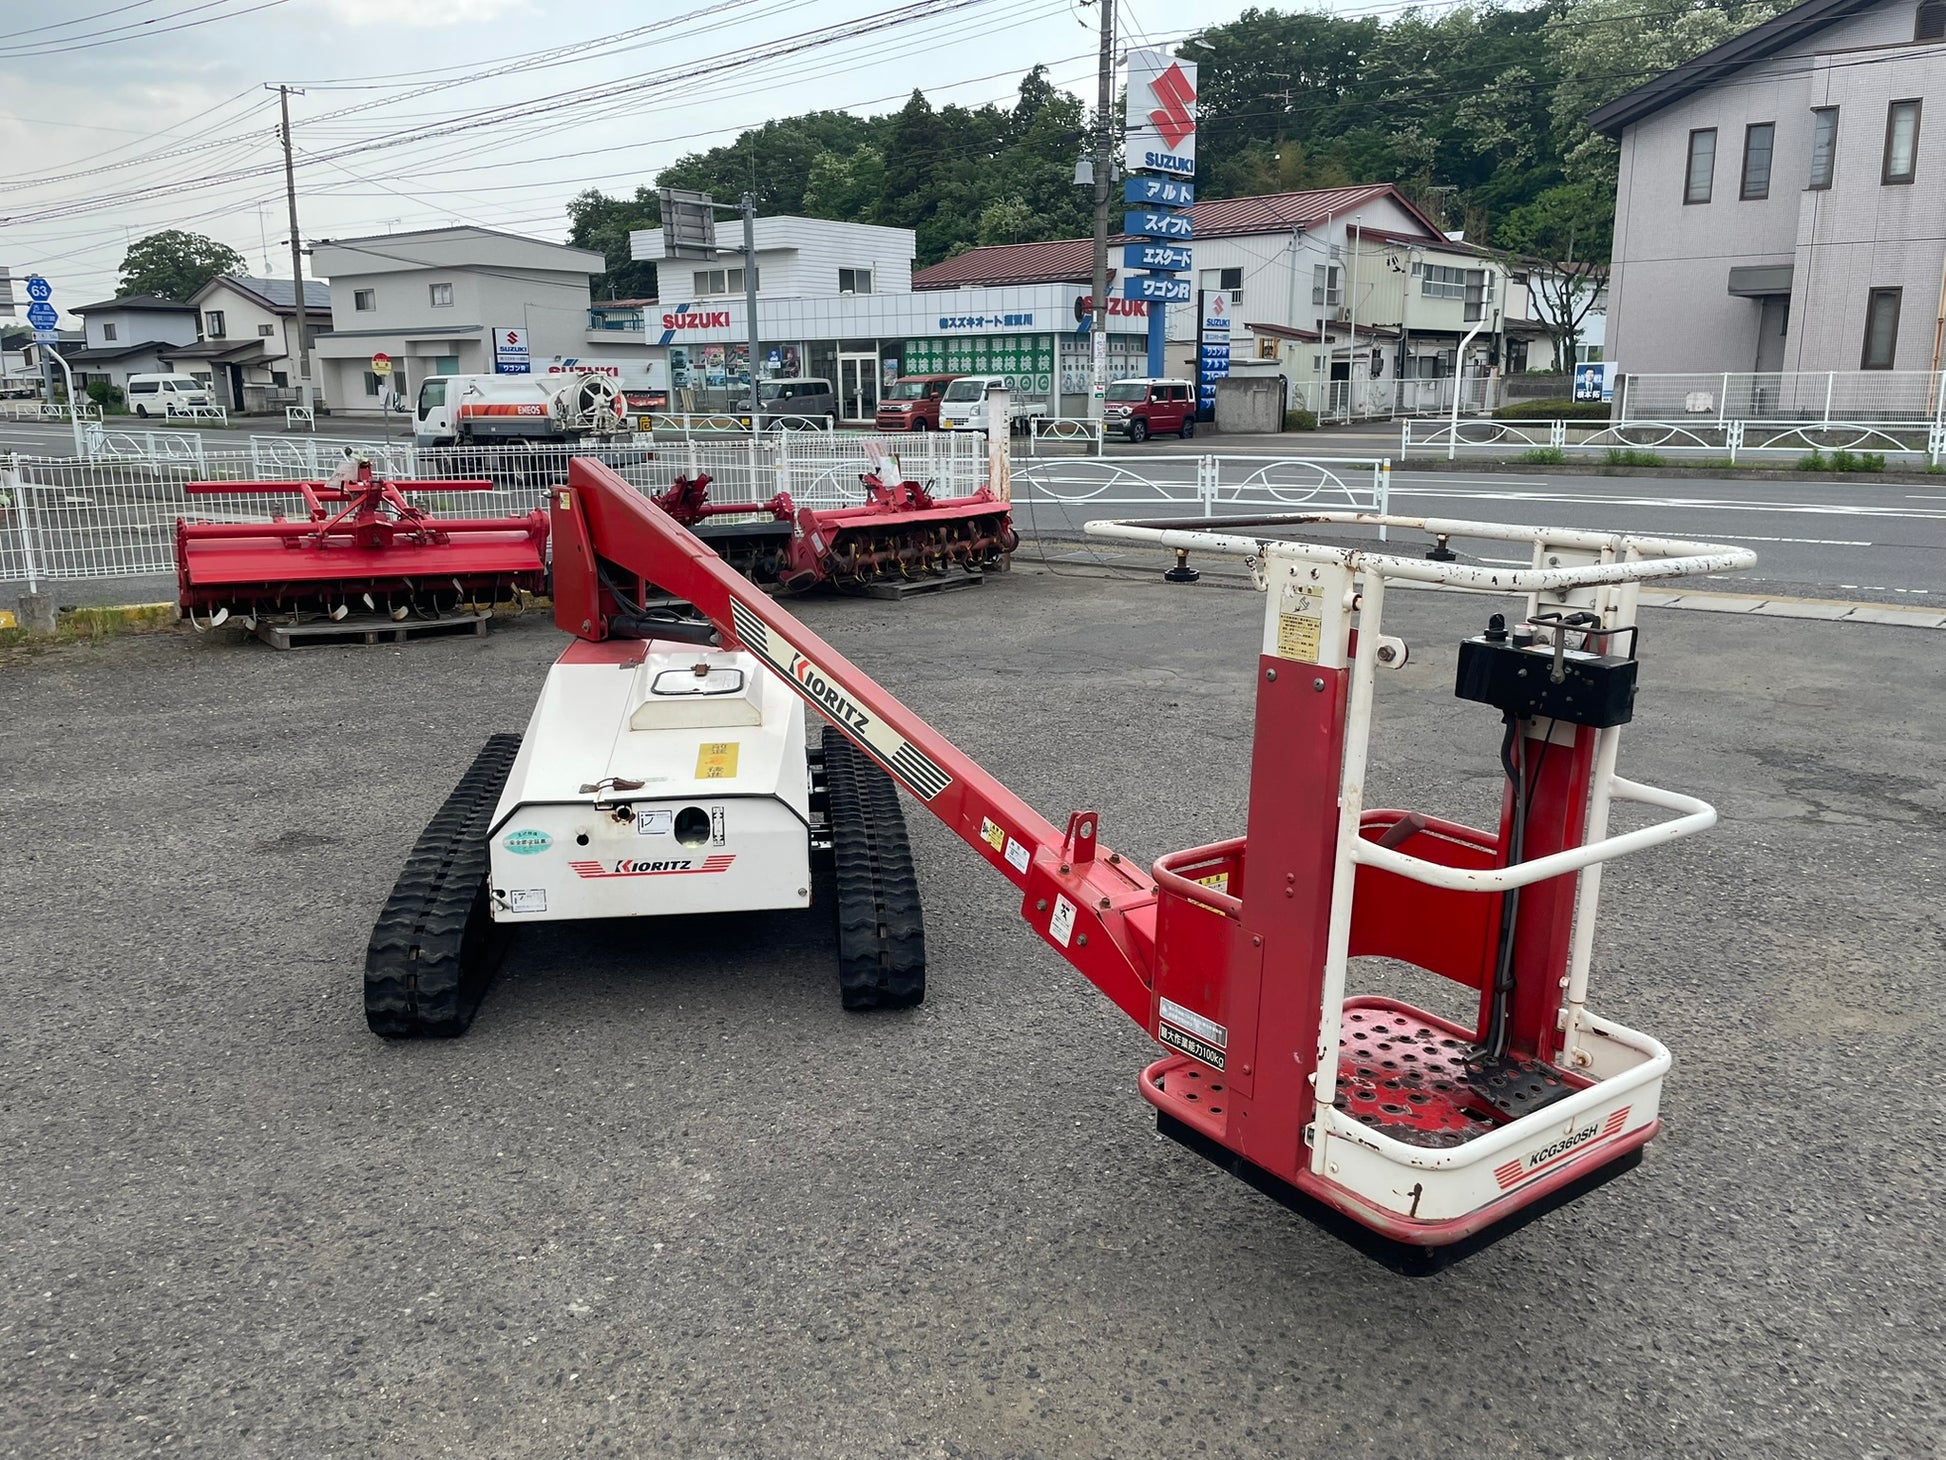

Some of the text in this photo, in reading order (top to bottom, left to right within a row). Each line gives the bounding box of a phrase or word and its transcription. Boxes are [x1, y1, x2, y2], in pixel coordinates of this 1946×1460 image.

[1145, 152, 1193, 173] SUZUKI
[1146, 181, 1191, 203] アルト
[1144, 214, 1191, 235] スイフト
[1143, 248, 1191, 267] エスクード
[31, 285, 48, 297] 63
[1143, 280, 1190, 299] ワゴンR
[1083, 296, 1150, 316] SZUKI
[663, 312, 730, 329] SUZUKI
[1206, 318, 1230, 327] SUZUKI
[906, 341, 917, 373] 車検
[918, 340, 929, 373] 車検
[932, 340, 943, 373] 車検
[948, 339, 959, 372] 車検
[960, 338, 972, 372] 車検
[975, 338, 987, 372] 車検
[991, 338, 1003, 372] 車検
[1004, 337, 1016, 372] 車検
[1020, 337, 1032, 372] 車検
[1038, 336, 1050, 371] 車検
[517, 405, 541, 415] ENEOS
[639, 416, 651, 431] 危
[789, 652, 870, 734] KIORITZ
[615, 860, 692, 873] KIORITZ
[1529, 1124, 1599, 1167] KCG360SH
